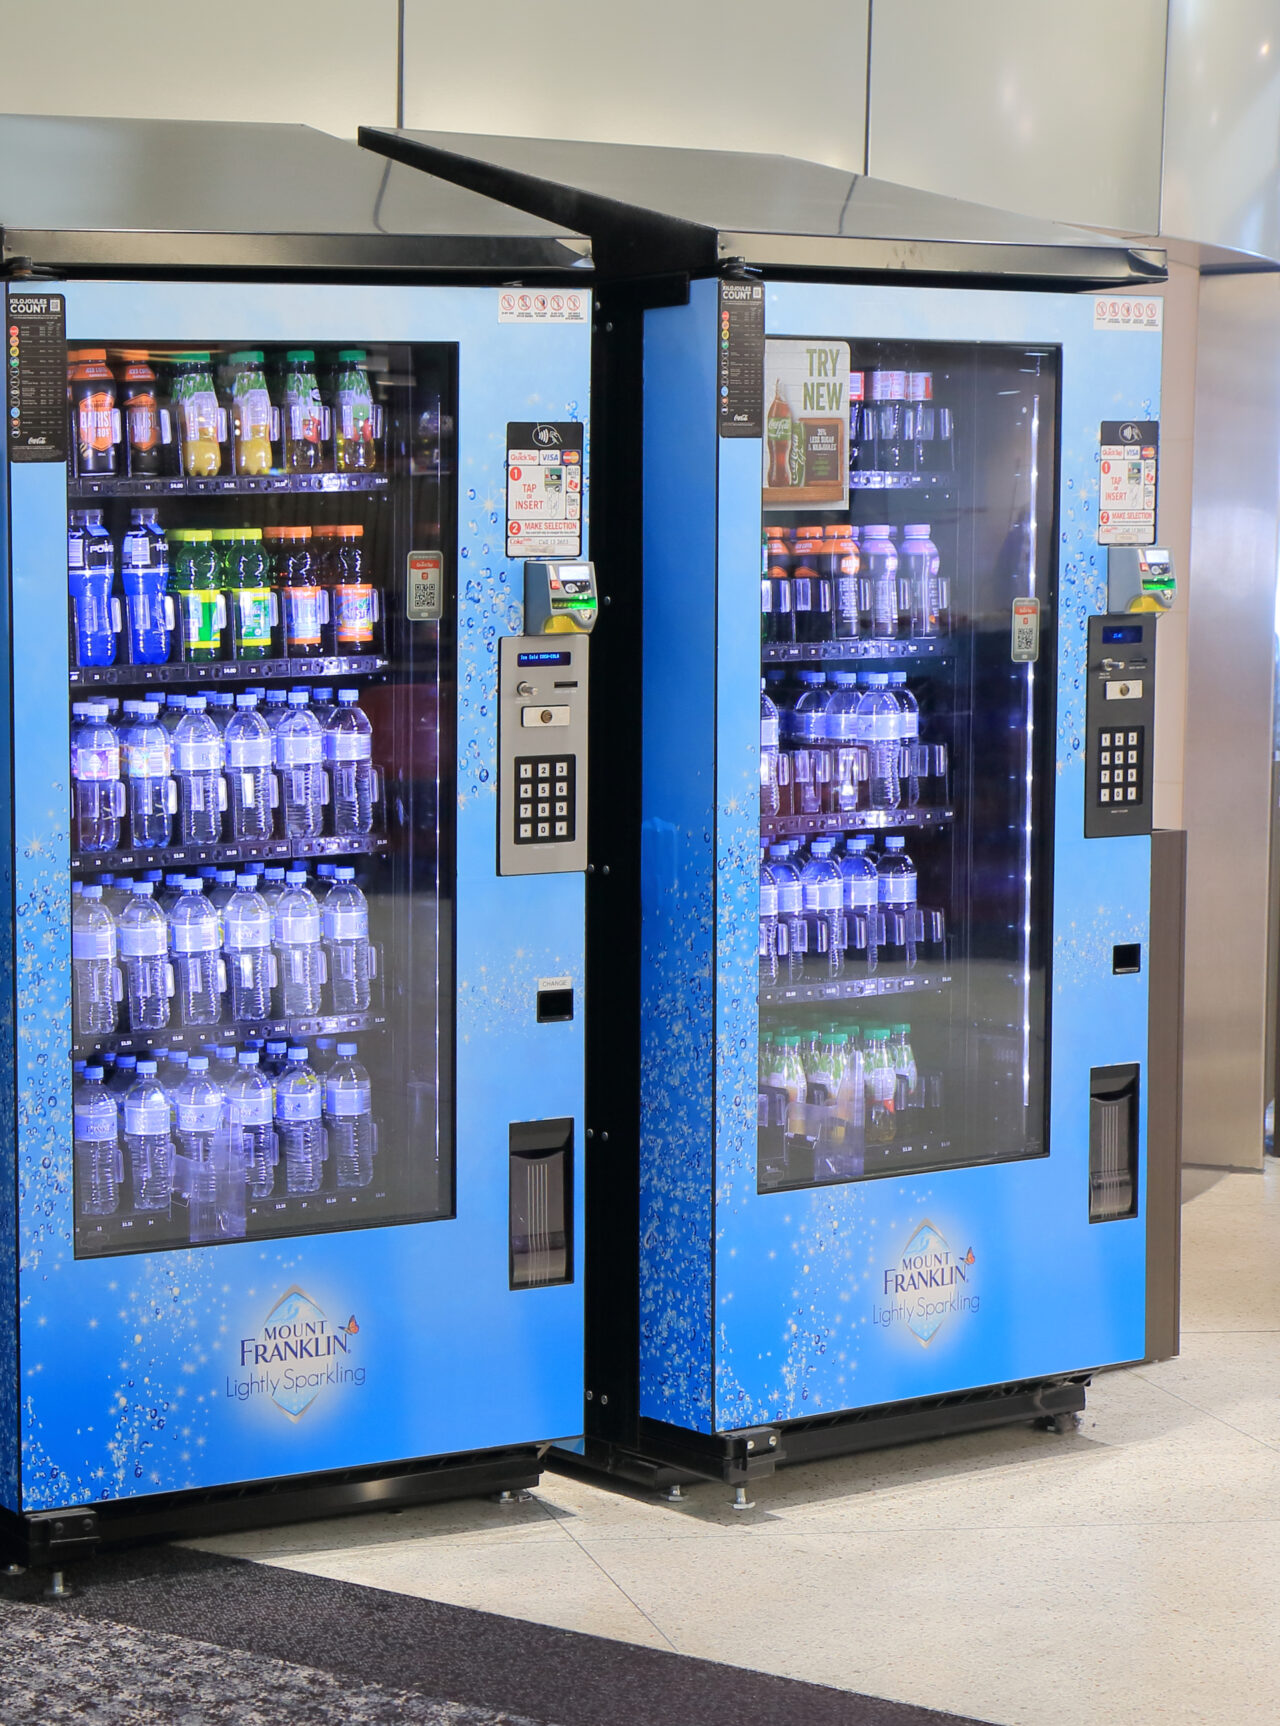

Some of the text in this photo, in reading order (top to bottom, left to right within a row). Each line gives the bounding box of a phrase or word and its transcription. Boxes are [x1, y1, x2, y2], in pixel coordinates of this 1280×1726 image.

[722, 291, 752, 300] COUNT
[10, 304, 47, 313] COUNT
[805, 348, 841, 377] TRY
[802, 382, 843, 411] NEW
[809, 435, 835, 444] LESS SUGAR
[1110, 476, 1122, 485] TAP
[522, 483, 537, 493] TAP
[1105, 492, 1128, 501] INSERT
[515, 500, 544, 510] INSERT
[1111, 511, 1126, 520] MAKE
[1127, 511, 1152, 520] SELECTION
[524, 522, 542, 531] MAKE
[543, 522, 577, 530] SELECTION
[542, 980, 568, 988] CHANGE
[902, 1251, 951, 1272] MOUNT
[883, 1265, 967, 1295] FRANKLIN
[872, 1291, 980, 1328] Lightly Sparkling
[264, 1320, 329, 1342] MOUNT
[239, 1333, 348, 1367] FRANKLIN
[226, 1362, 366, 1401] Lightly Sparkling
